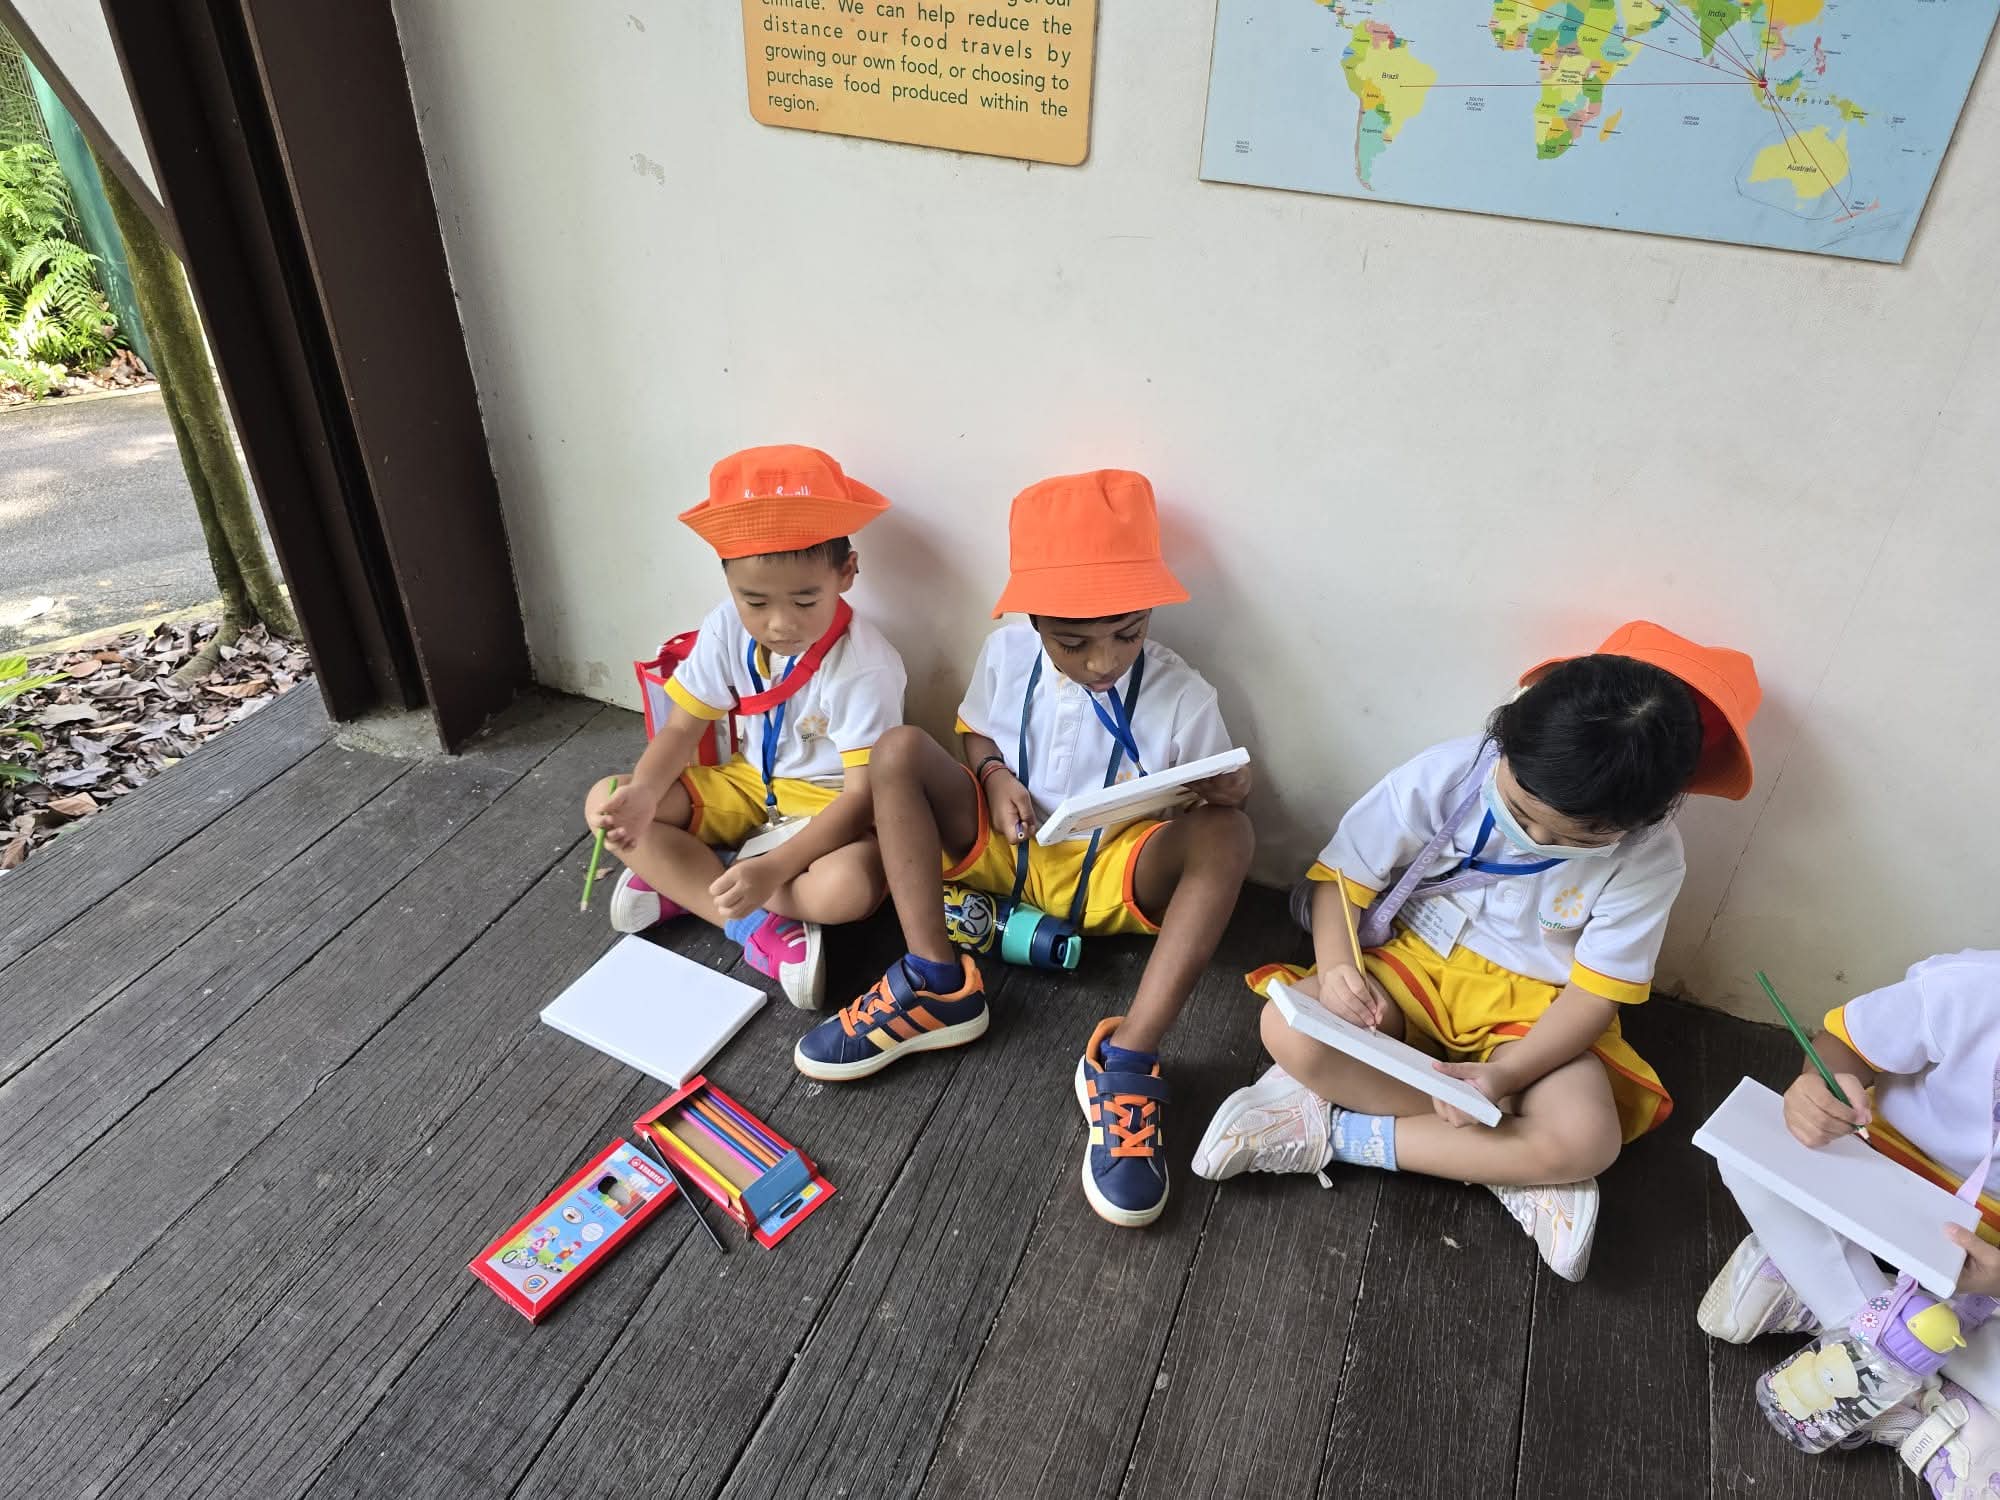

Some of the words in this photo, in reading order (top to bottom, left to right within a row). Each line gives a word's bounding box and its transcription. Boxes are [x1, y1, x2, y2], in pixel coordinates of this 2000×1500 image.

[762, 0, 825, 10] mate.
[838, 0, 864, 15] We
[876, 4, 905, 19] can
[917, 2, 955, 29] help
[968, 9, 1030, 31] reduce
[1042, 15, 1072, 36] the
[1707, 9, 1726, 18] India
[763, 13, 843, 39] distance
[857, 28, 889, 44] our
[901, 27, 947, 50] food
[961, 37, 1032, 59] travels
[1047, 43, 1071, 68] by
[765, 45, 826, 67] growing
[832, 52, 857, 66] our
[863, 56, 895, 71] own
[900, 54, 943, 79] food,
[949, 65, 967, 79] or
[972, 64, 1045, 92] choosing
[1051, 74, 1069, 91] to
[1381, 72, 1400, 80] Brazil
[767, 69, 834, 89] purchase
[843, 74, 880, 95] food
[892, 83, 968, 105] produced
[980, 92, 1028, 113] within
[1041, 98, 1068, 117] the
[768, 93, 820, 112] region.
[1786, 163, 1818, 174] Australia
